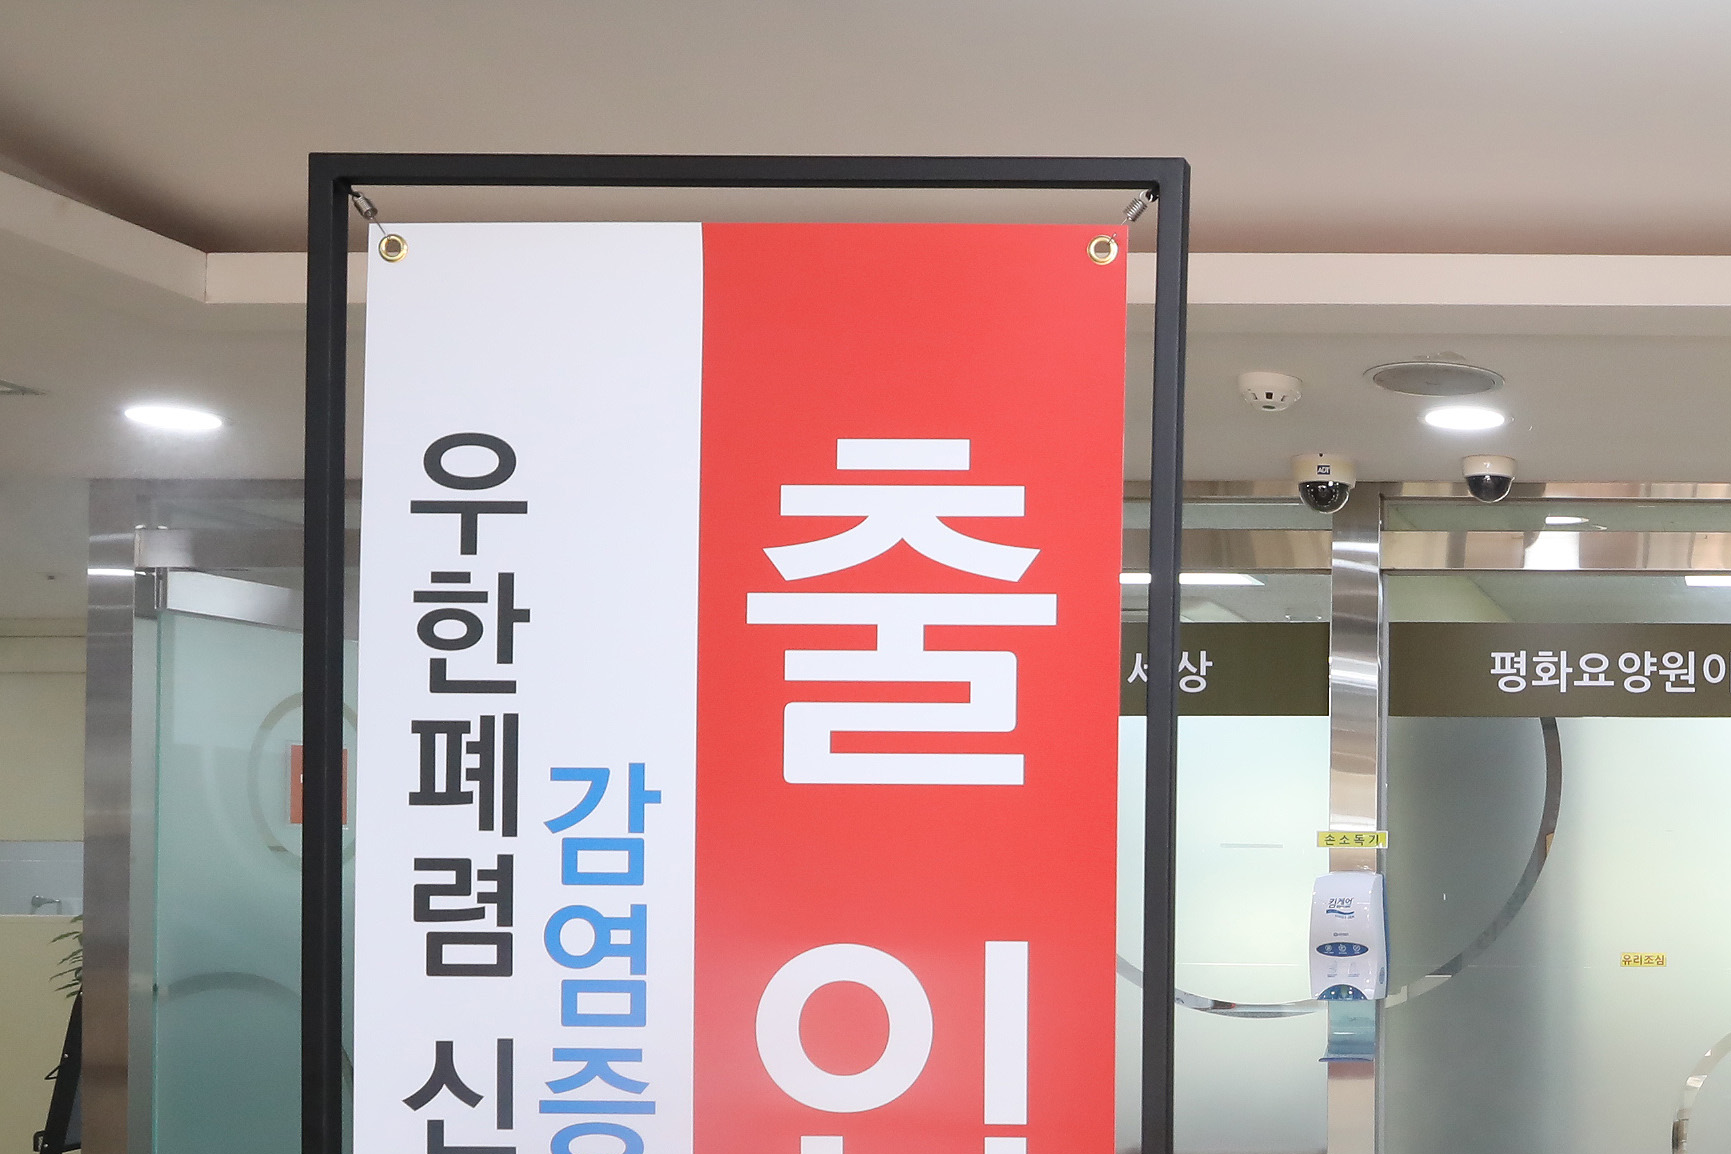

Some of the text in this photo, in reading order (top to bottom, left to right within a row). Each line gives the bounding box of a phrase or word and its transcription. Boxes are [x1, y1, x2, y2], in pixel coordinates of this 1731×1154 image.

[409, 433, 530, 977] 우한폐렴
[1324, 834, 1379, 846] 손소독기
[1622, 954, 1665, 966] 유리조심
